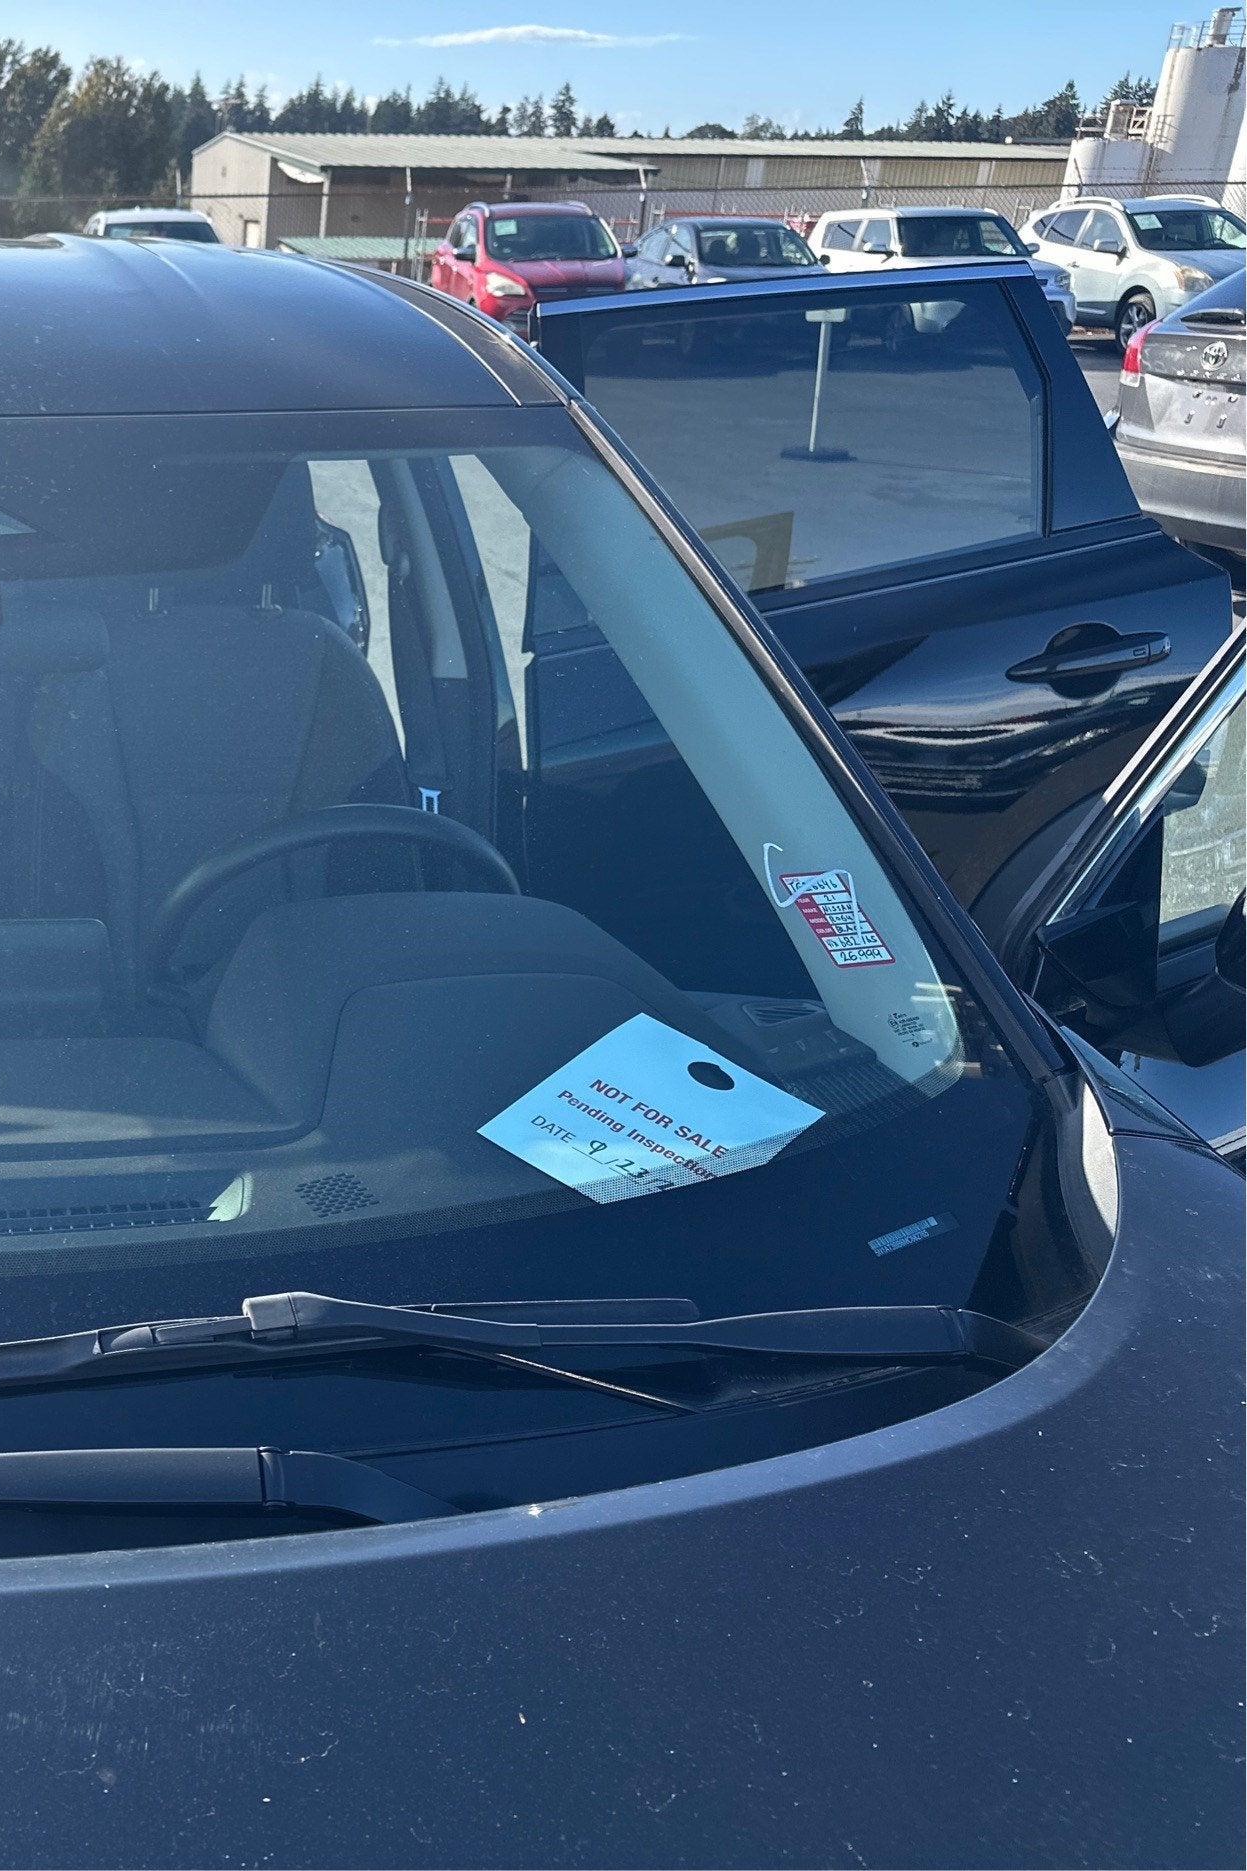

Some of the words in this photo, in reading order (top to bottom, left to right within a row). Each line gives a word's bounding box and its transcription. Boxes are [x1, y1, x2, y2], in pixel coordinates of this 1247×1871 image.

[530, 1115, 577, 1144] DATE
[557, 1089, 625, 1133] Pending
[626, 1128, 717, 1179] Inspection
[588, 1078, 633, 1106] NOT
[631, 1102, 674, 1129] FOR
[674, 1125, 729, 1159] SALE
